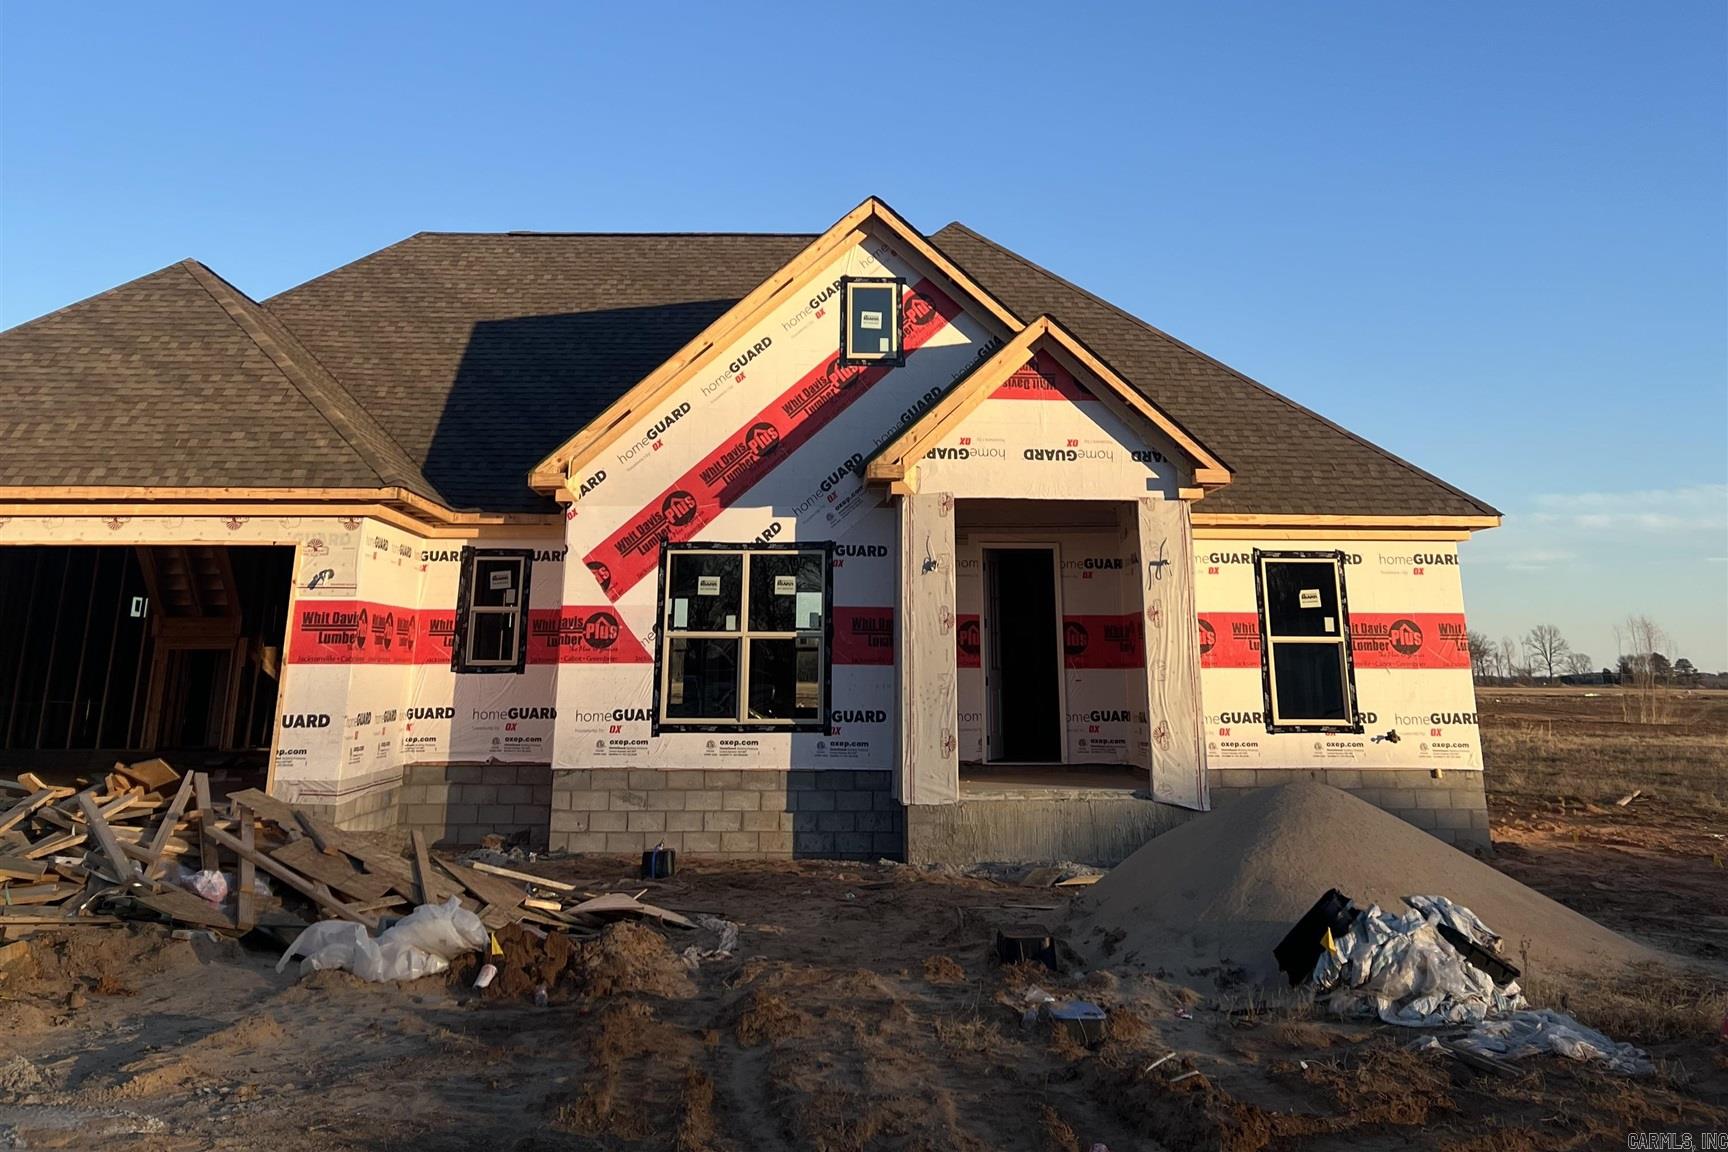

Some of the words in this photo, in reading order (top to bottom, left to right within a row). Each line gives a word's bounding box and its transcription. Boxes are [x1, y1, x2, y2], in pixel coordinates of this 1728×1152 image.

[701, 336, 773, 397] homeGUARD
[801, 375, 829, 399] Davis
[617, 401, 691, 465] homeGUARD
[873, 386, 942, 448] homeGUARD
[699, 464, 724, 483] Whit
[720, 441, 747, 465] Davis
[748, 427, 778, 454] Plus
[1024, 448, 1114, 462] homeGUARD
[792, 452, 864, 517] homeGUARD
[614, 530, 638, 554] Whit
[636, 511, 663, 536] Davis
[665, 495, 696, 524] Plus
[303, 612, 329, 624] Whit
[585, 617, 619, 640] Plus
[1361, 623, 1388, 635] Davis
[1391, 623, 1422, 646] Plus
[472, 707, 557, 720] homeGUARD
